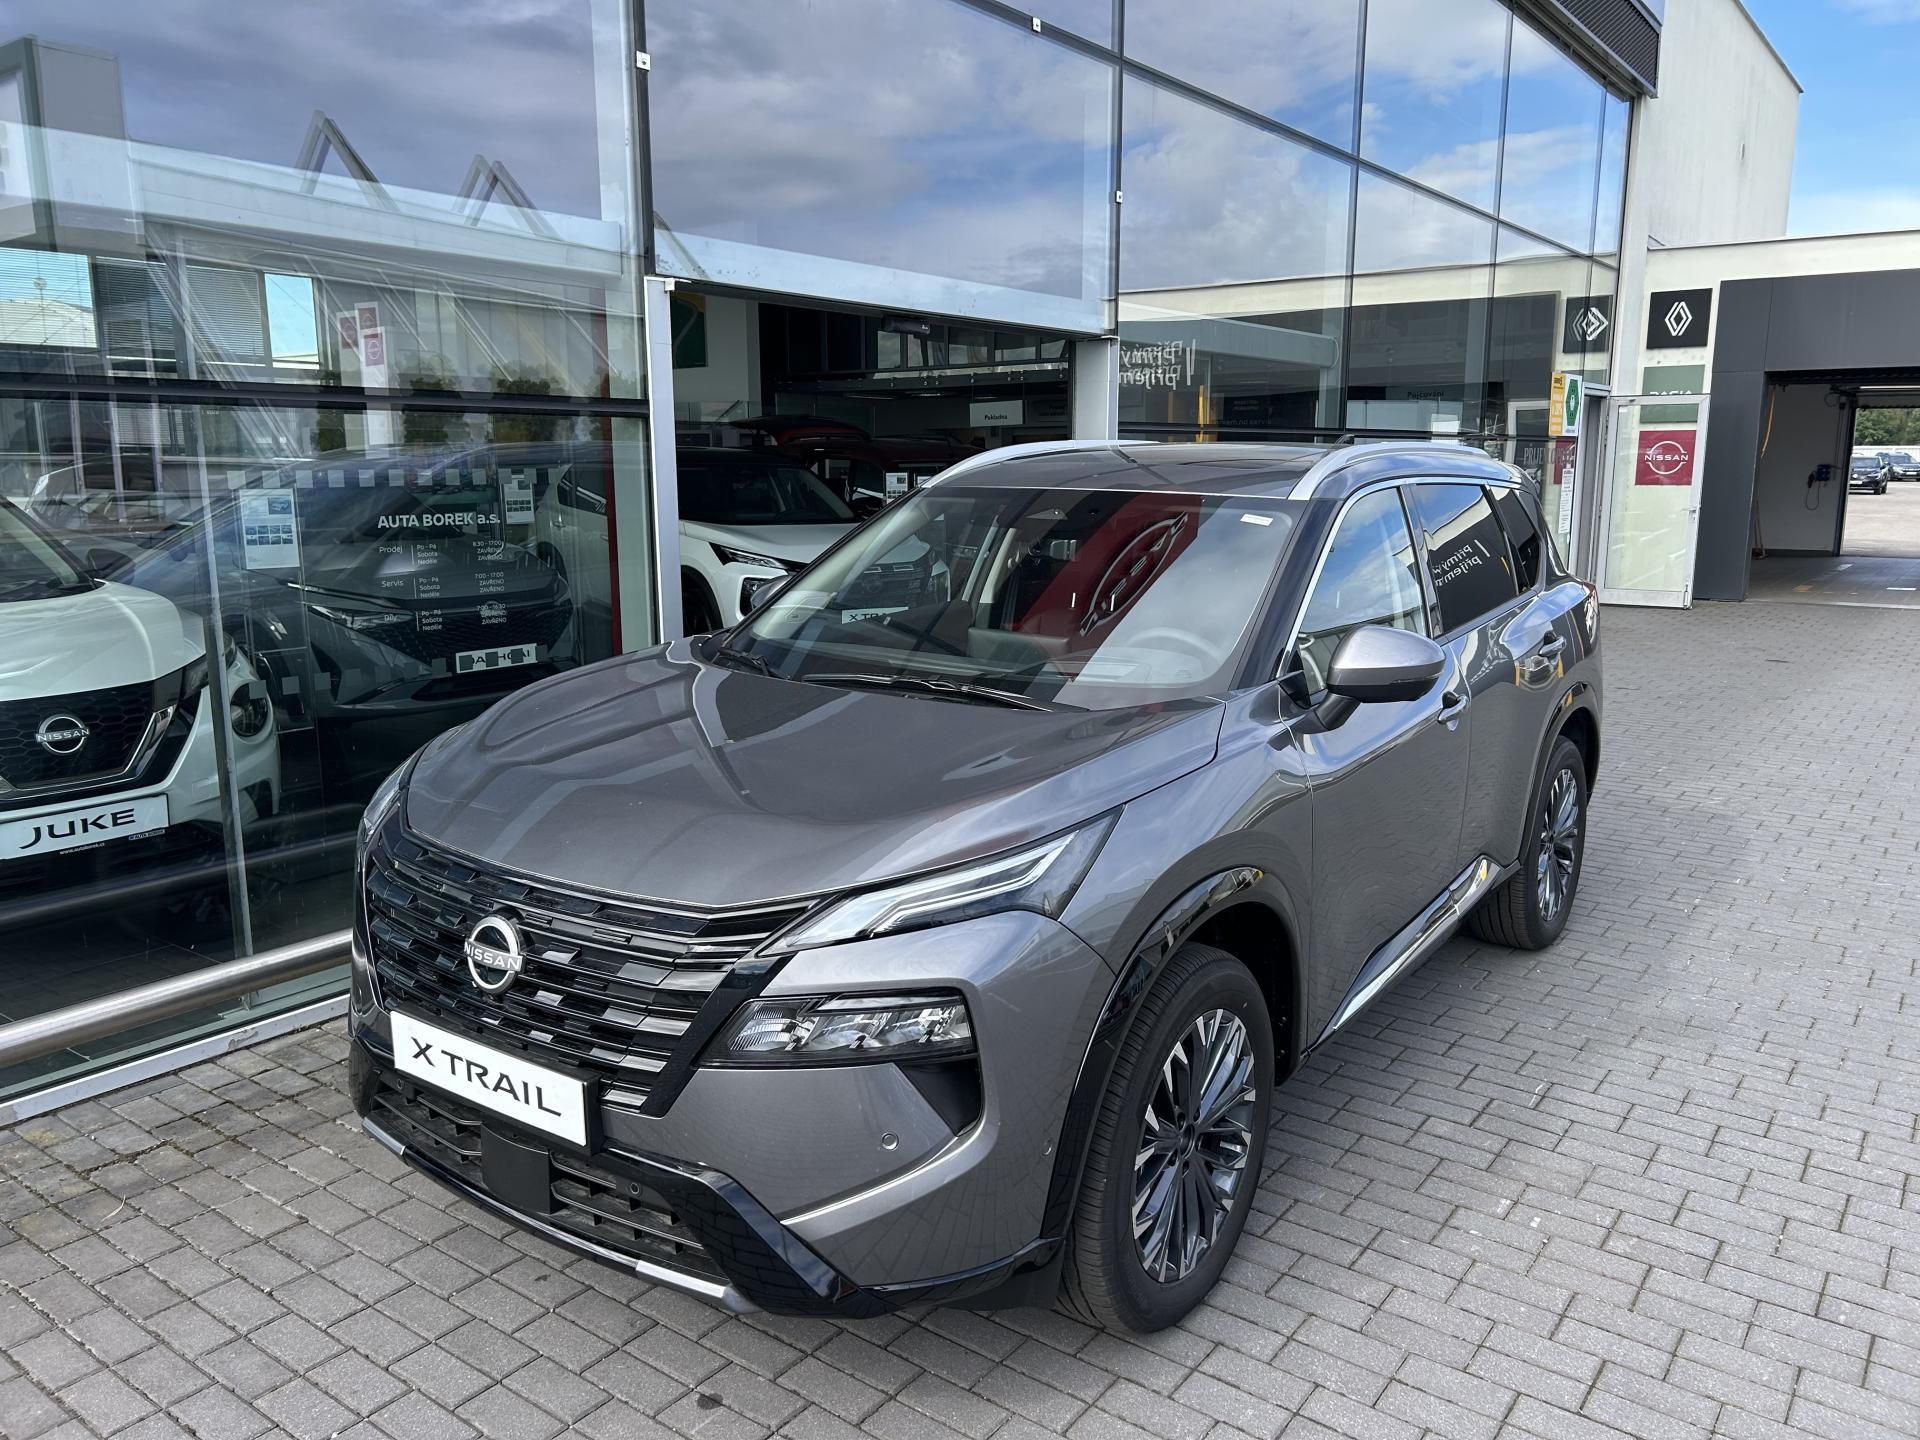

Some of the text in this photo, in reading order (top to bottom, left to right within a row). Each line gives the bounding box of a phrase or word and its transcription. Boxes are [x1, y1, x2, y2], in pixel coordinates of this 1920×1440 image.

[1644, 453, 1689, 461] NISSAN
[377, 511, 501, 529] AUTA BOREK a.s.
[379, 546, 403, 554] Prodej
[381, 580, 404, 588] Servis
[36, 729, 90, 743] NISSAN
[18, 808, 137, 850] JUKE
[463, 941, 520, 970] NISSAN
[410, 1036, 562, 1117] X TRAIL
